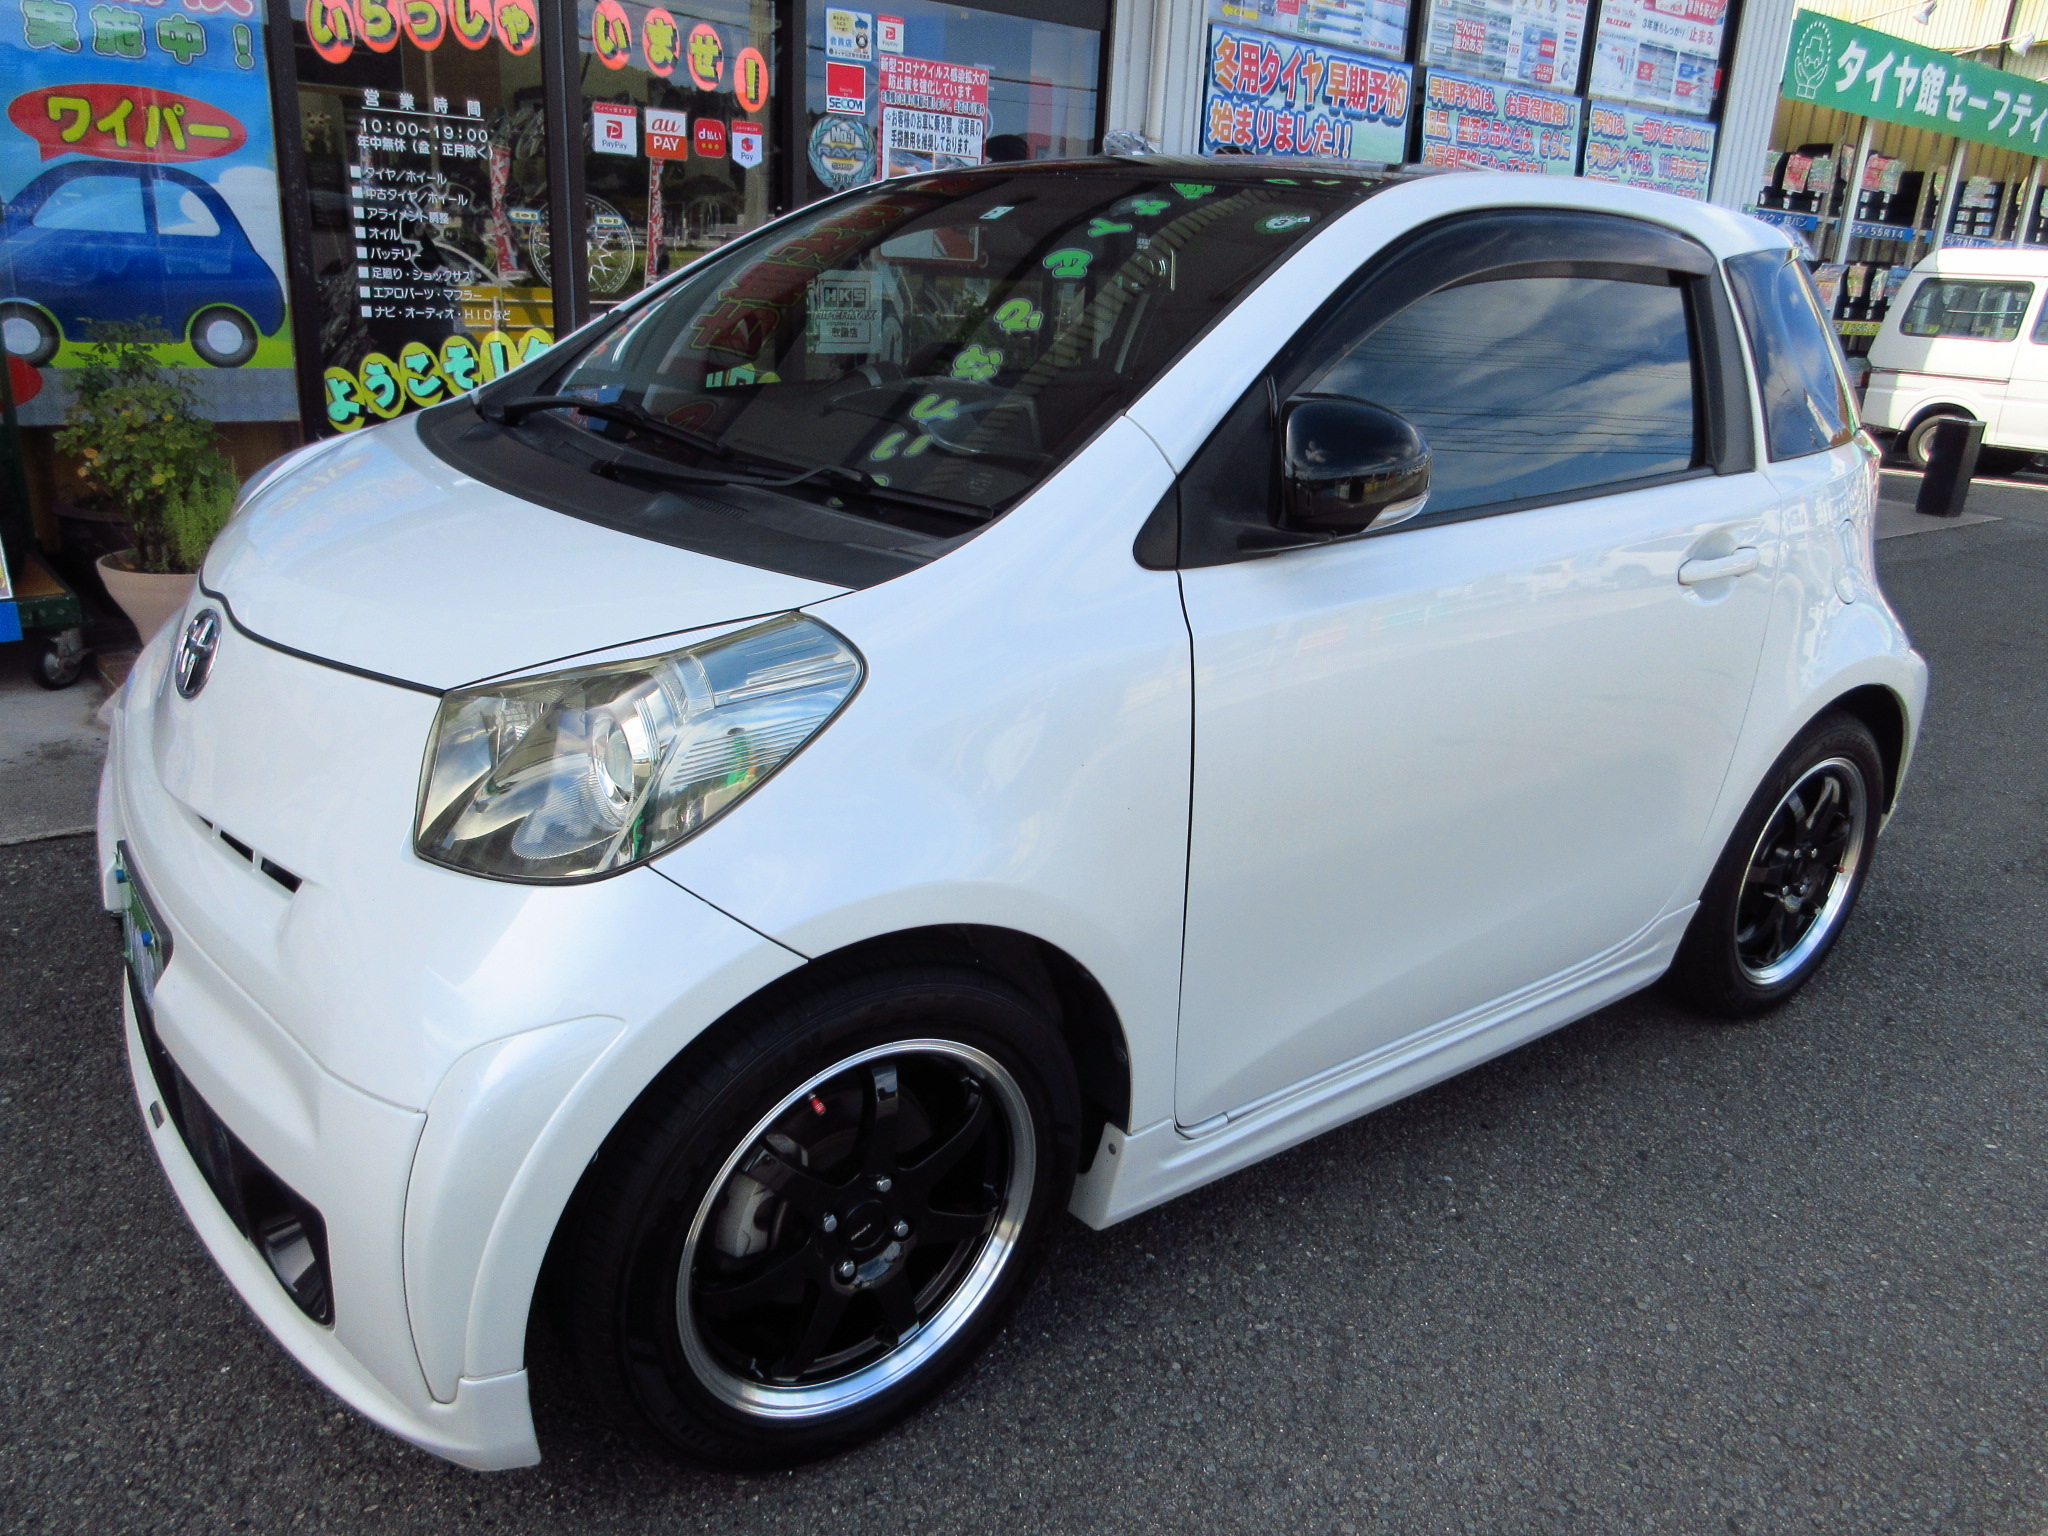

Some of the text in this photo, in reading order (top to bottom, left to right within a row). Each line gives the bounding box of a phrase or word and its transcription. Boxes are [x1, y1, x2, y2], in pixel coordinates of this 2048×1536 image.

[363, 88, 482, 118] 営業時間
[829, 97, 863, 111] SECOM
[48, 96, 231, 151] ワイパー
[651, 118, 681, 133] au
[698, 128, 722, 141] d払い
[601, 139, 628, 149] PayPay
[653, 136, 680, 151] PAY
[741, 152, 754, 162] Pay
[817, 144, 869, 162] RAYS
[365, 167, 448, 185] タイヤ/ホイール
[365, 188, 469, 206] 中古タイヤ/ホイール
[366, 207, 450, 225] アライメント調整
[368, 227, 401, 241] オイル
[370, 247, 422, 261] バッテリー
[373, 287, 482, 301] エアロパーツ・マフラー
[824, 287, 866, 304] HKS
